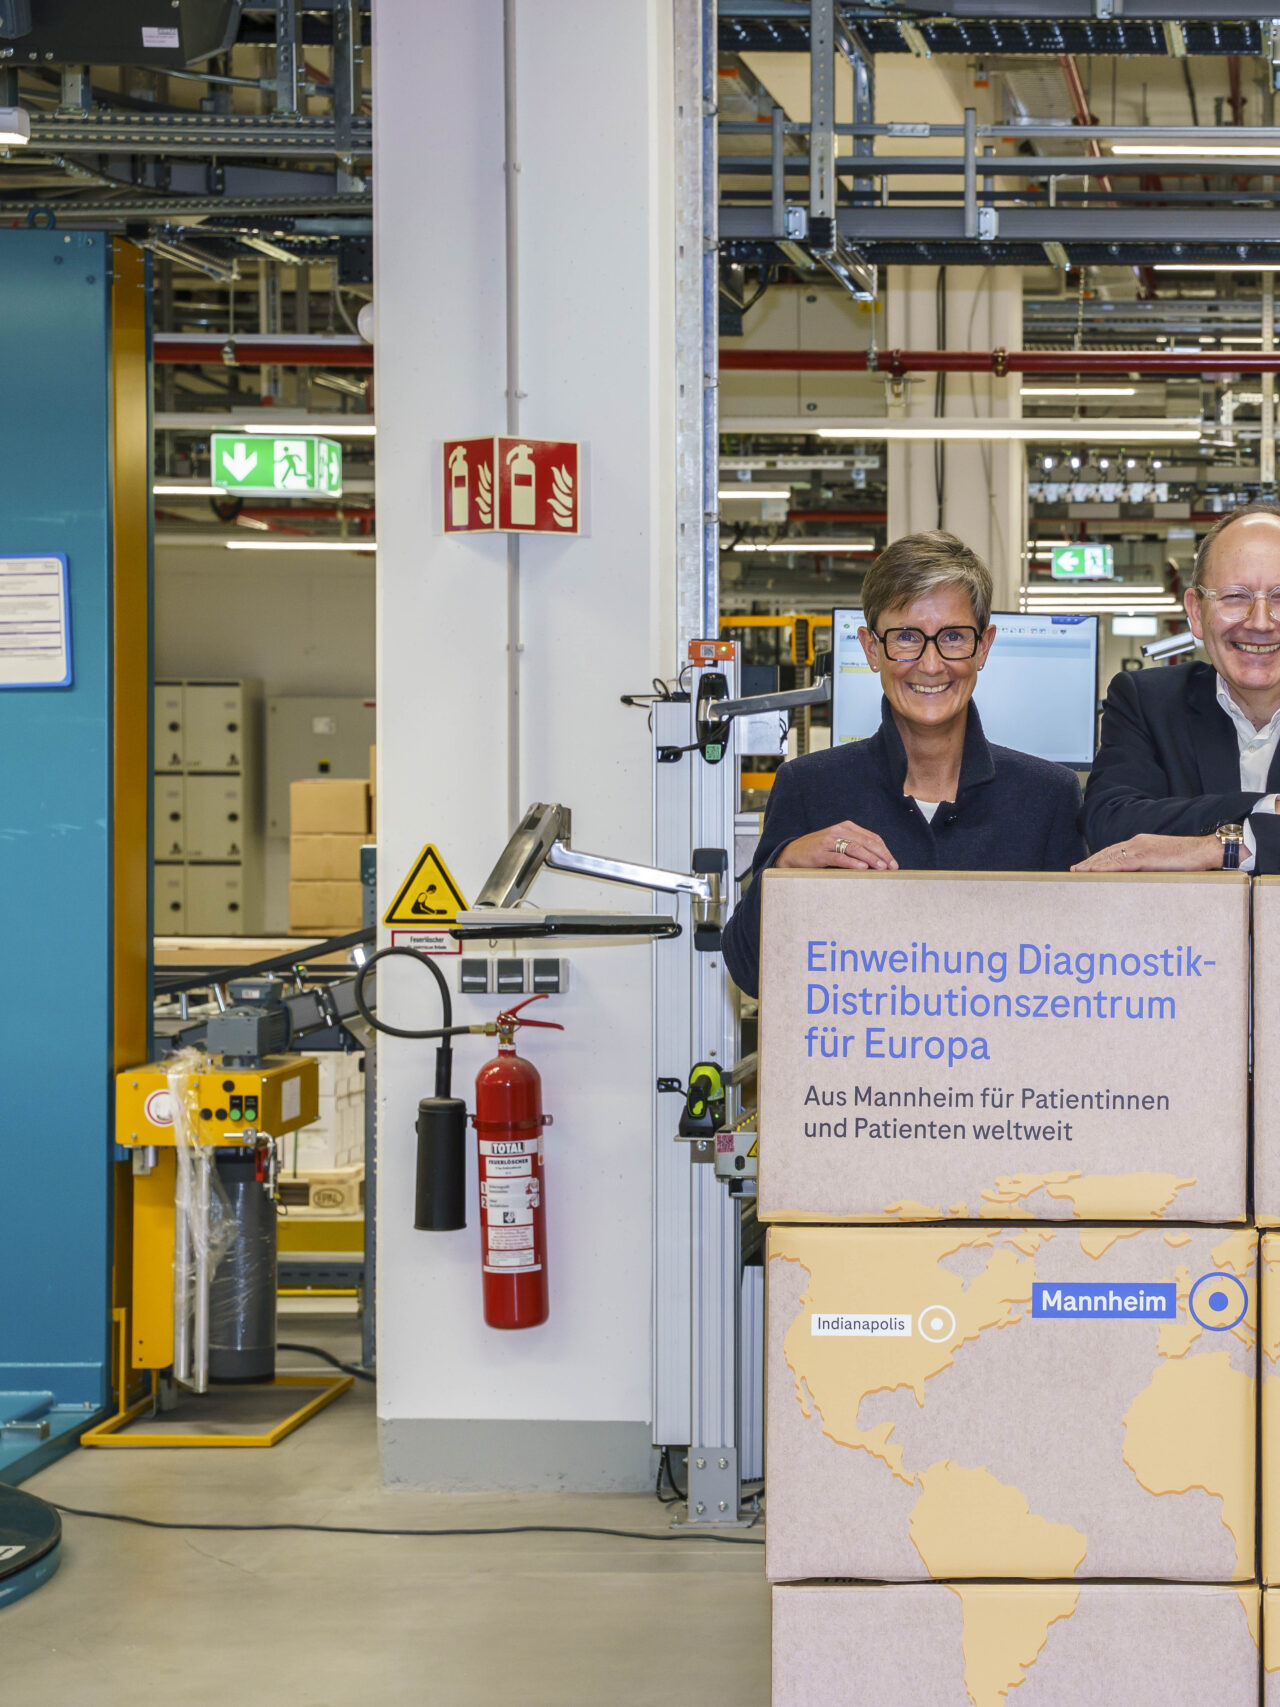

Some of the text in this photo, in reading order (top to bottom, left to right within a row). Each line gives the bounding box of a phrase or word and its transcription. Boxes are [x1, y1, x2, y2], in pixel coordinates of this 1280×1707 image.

[410, 935, 444, 944] Feuerlöscher
[807, 941, 1216, 984] Einweihung Diagnostik-
[807, 984, 1176, 1019] Distributionszentrum
[804, 1027, 991, 1067] für Europa
[803, 1086, 1170, 1111] Aus Mannheim für Patientinnen
[804, 1117, 1073, 1141] und Patienten weltweit
[492, 1142, 524, 1154] TOTAL
[1042, 1289, 1167, 1312] Mannheim
[816, 1316, 905, 1334] Indianapolis
